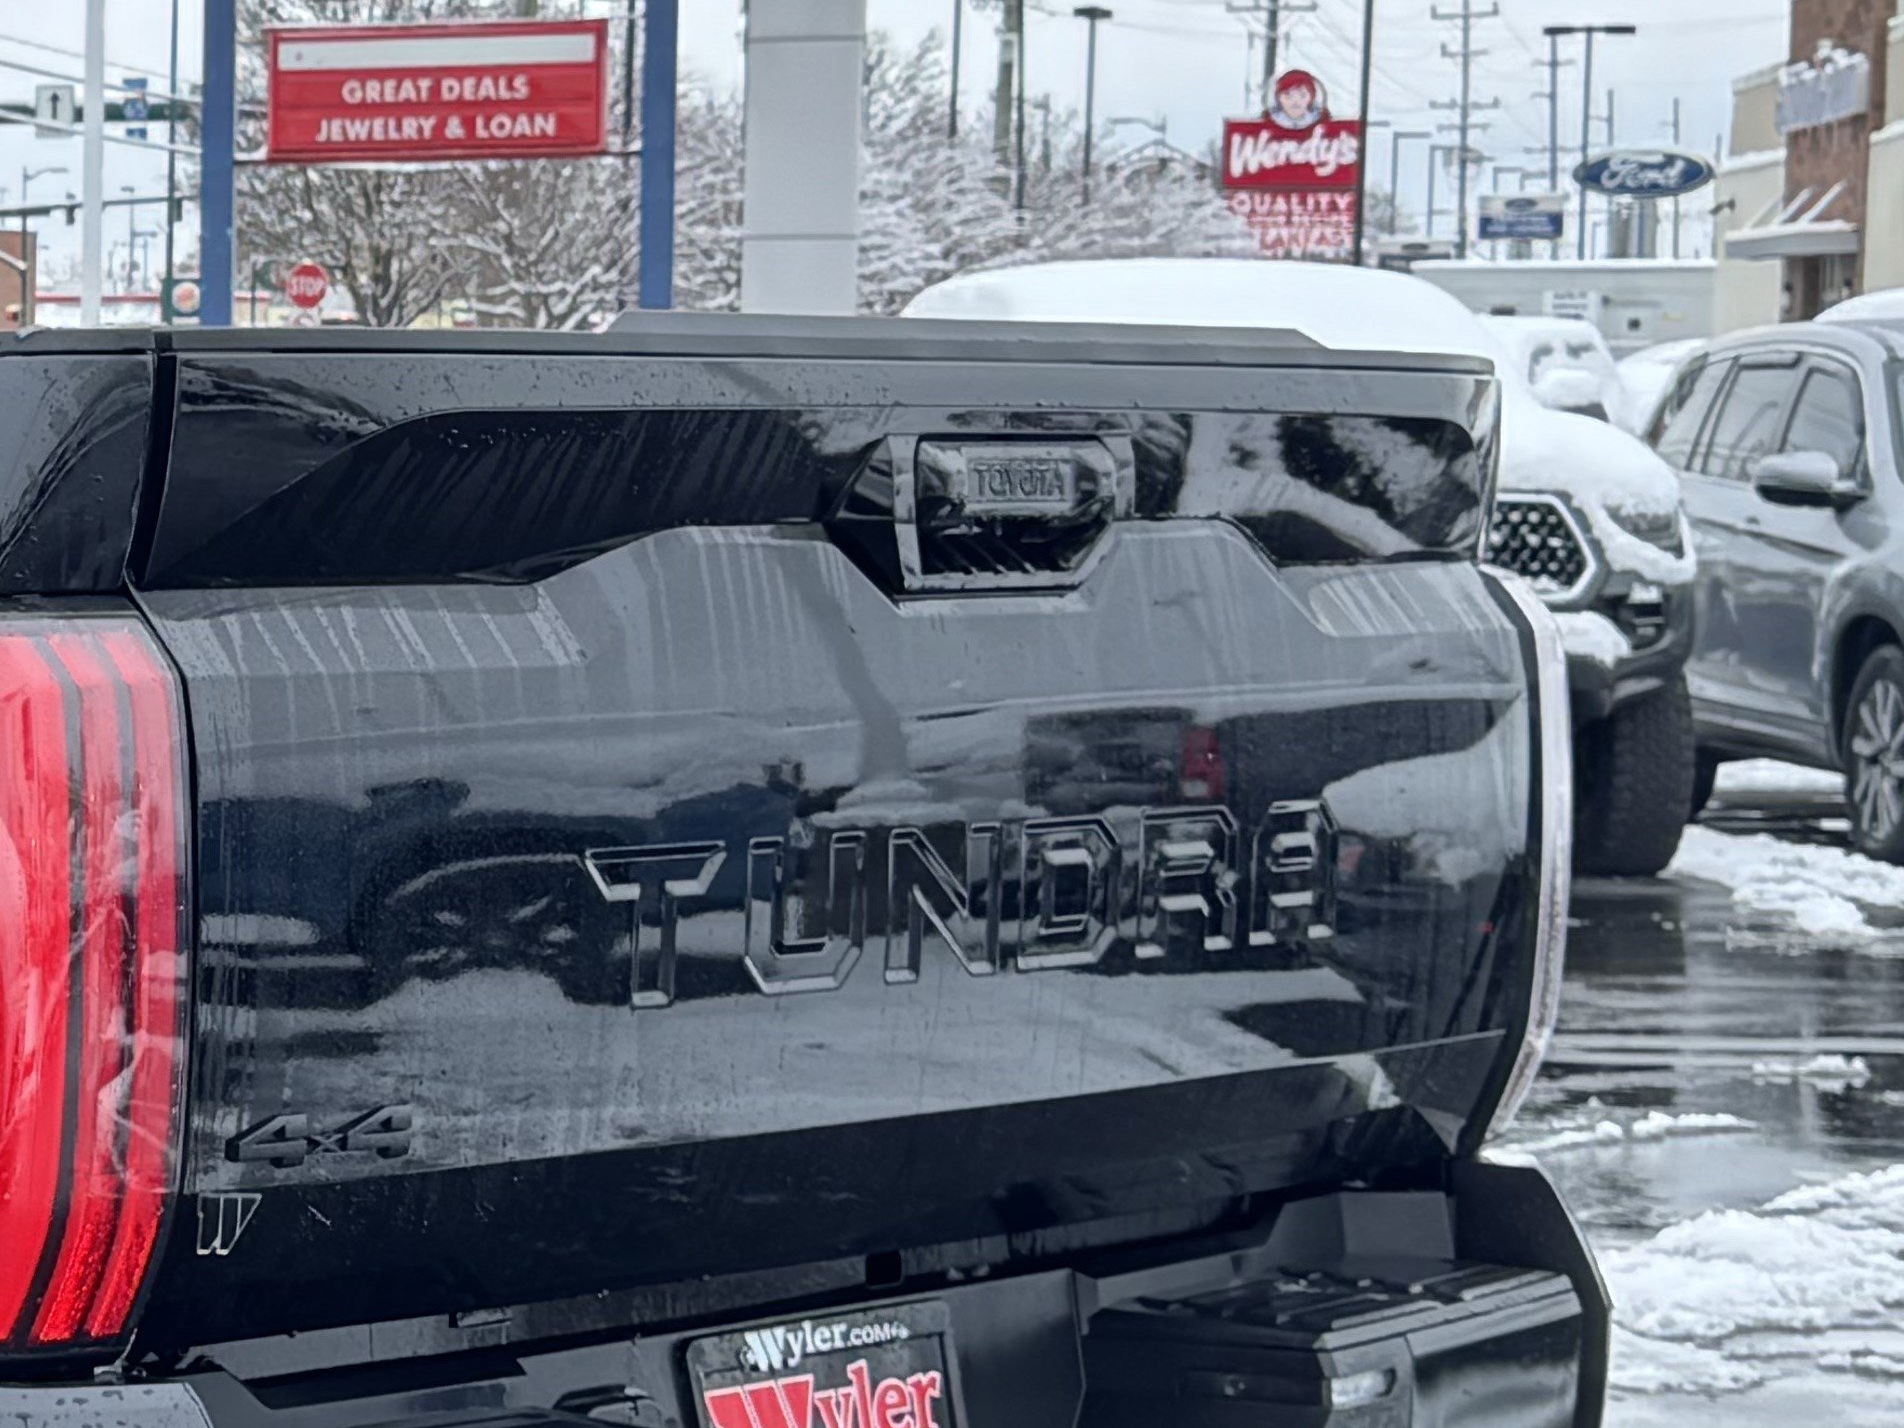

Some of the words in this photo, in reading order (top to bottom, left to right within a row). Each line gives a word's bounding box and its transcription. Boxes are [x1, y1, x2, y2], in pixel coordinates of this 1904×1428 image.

[341, 77, 434, 104] GREAT
[440, 74, 531, 101] DEALS
[315, 115, 437, 143] JEWELRY
[444, 115, 466, 140] &
[475, 112, 558, 140] LOAN
[1229, 123, 1359, 179] Wendy's
[1600, 152, 1688, 190] Ford
[1228, 191, 1356, 214] QUALITY
[288, 275, 326, 297] STOP
[583, 798, 1339, 1010] TUNDRA
